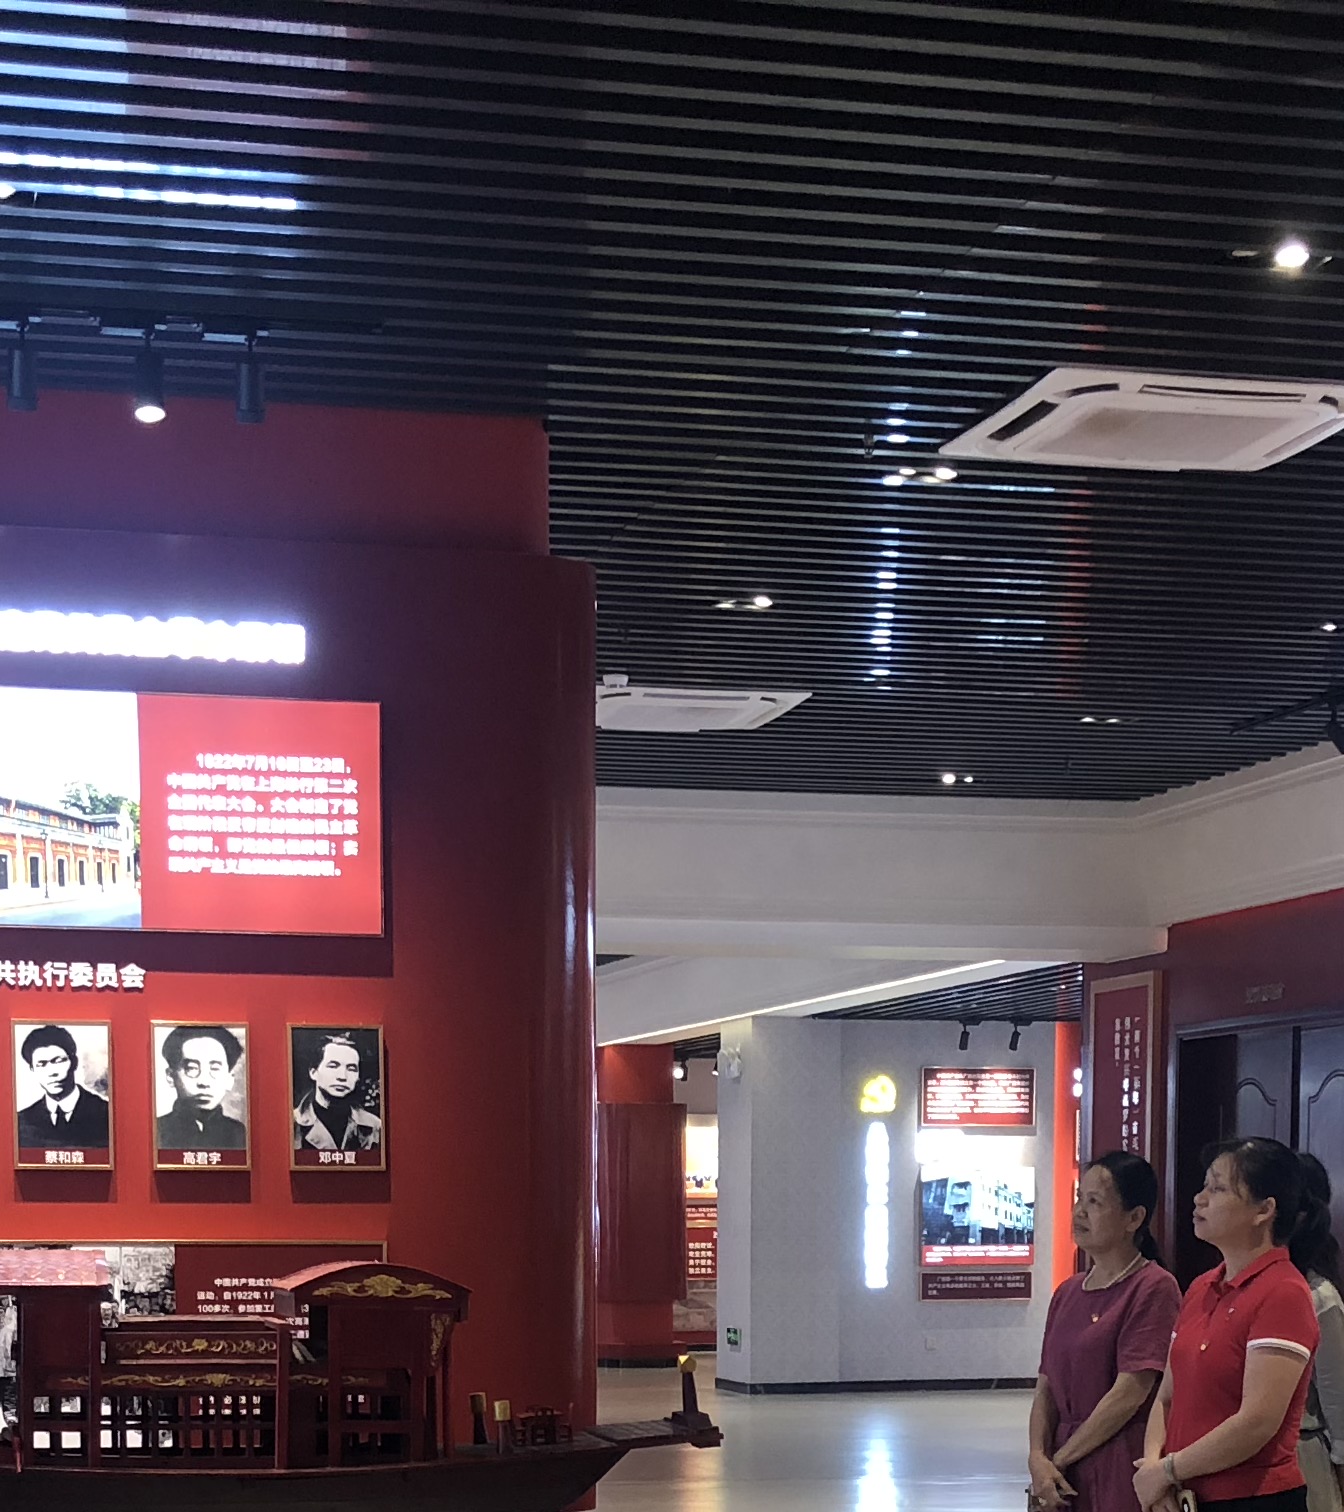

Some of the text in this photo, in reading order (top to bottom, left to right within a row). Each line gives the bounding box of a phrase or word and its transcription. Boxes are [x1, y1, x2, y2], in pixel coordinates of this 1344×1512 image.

[45, 1150, 85, 1164] 蔡和森
[183, 1151, 222, 1165] 高君宇
[318, 1151, 357, 1165] 邓中夏
